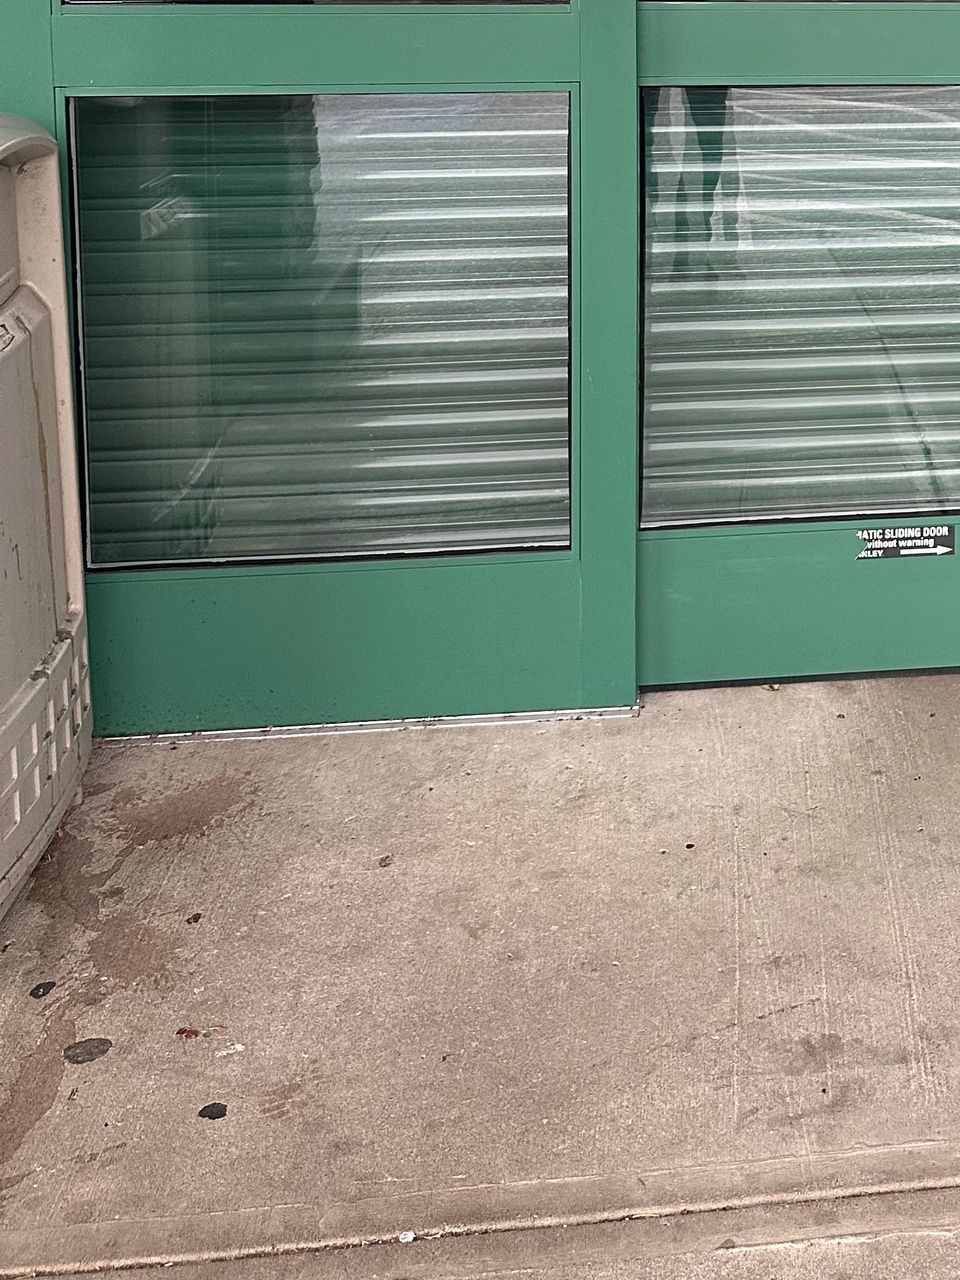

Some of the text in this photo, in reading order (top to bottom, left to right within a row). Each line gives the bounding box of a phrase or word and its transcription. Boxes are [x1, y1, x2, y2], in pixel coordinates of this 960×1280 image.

[885, 527, 921, 539] SLIDING
[923, 526, 948, 536] DOOR
[898, 537, 934, 547] warning
